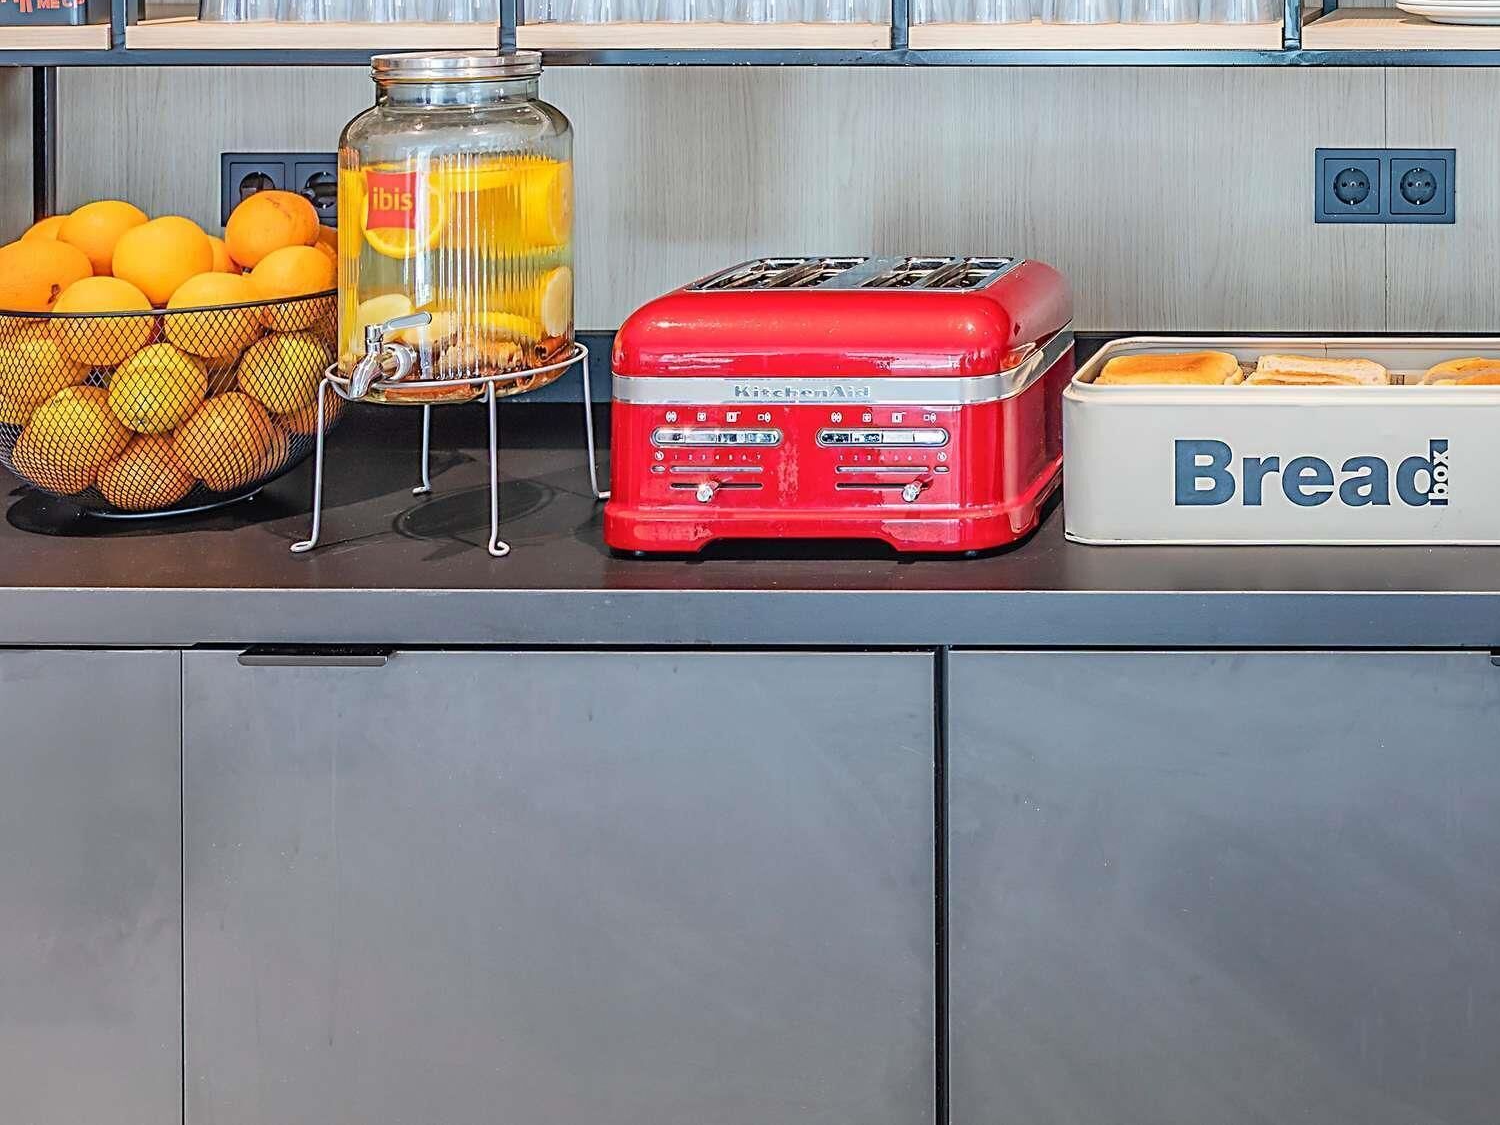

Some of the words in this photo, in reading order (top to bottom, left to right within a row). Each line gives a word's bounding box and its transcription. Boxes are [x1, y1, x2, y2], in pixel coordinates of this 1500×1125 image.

[372, 187, 413, 211] ibis
[734, 385, 870, 398] KitchenAid
[1174, 439, 1449, 507] Bread
[1428, 450, 1449, 500] box
